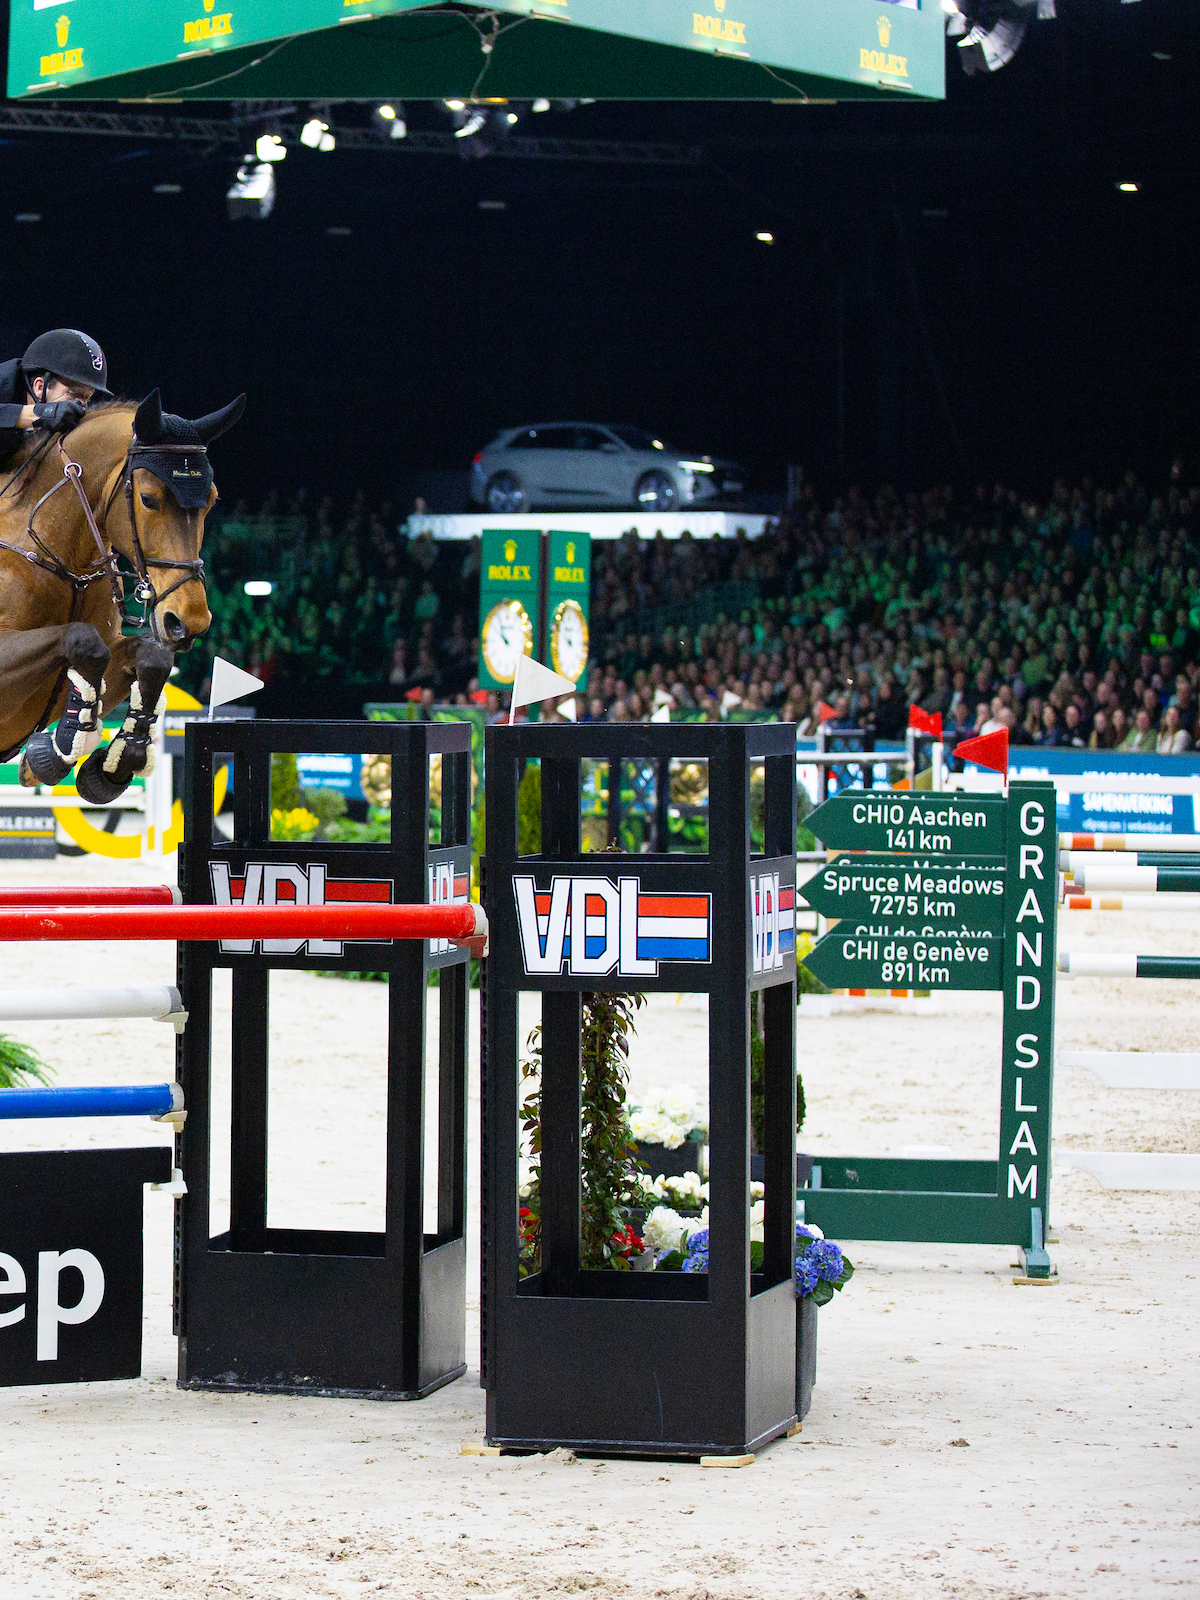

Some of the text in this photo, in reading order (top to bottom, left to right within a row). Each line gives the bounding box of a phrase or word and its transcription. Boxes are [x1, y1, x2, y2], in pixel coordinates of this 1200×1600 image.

[184, 13, 233, 43] ROLEX
[693, 13, 747, 44] ROLEX
[40, 47, 84, 76] ROLEX
[859, 48, 909, 77] ROLEX
[488, 565, 531, 580] ROLEX
[853, 804, 987, 827] CHIO Aachen
[886, 829, 952, 850] 141 km
[823, 871, 1004, 895] Spruce Meadows
[208, 861, 344, 956] VDL
[870, 895, 956, 916] 7275 km
[1015, 801, 1045, 1010] GRAND
[512, 875, 659, 977] VDL
[750, 872, 783, 974] VDL
[843, 939, 989, 961] CHI de Genève
[882, 962, 950, 983] 891 km
[1007, 1034, 1039, 1199] SLAM
